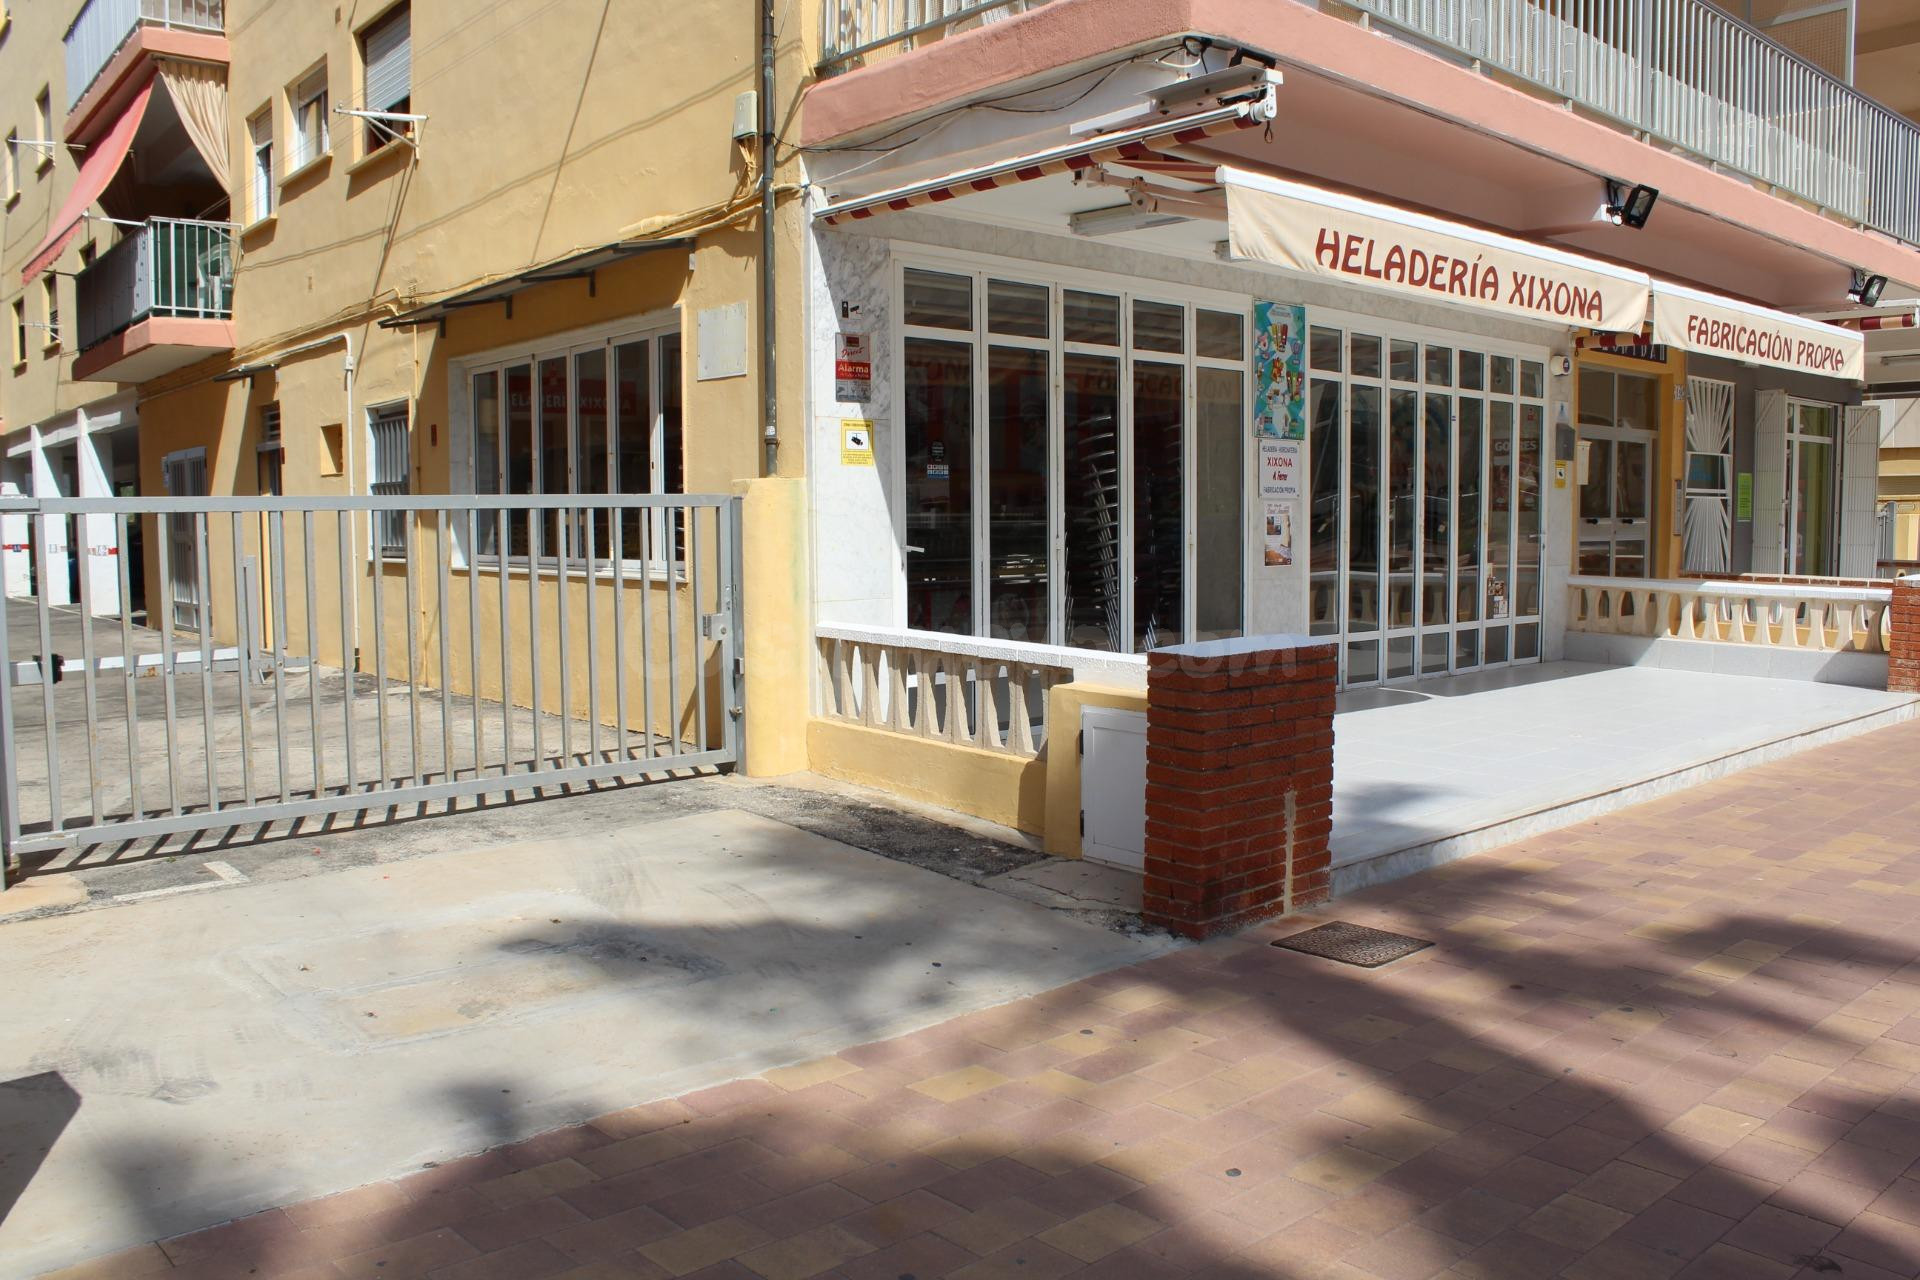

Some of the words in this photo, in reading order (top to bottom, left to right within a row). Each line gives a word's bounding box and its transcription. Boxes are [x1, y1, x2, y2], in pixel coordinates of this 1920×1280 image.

[1315, 228, 1498, 301] HELADERÍA
[1508, 271, 1603, 323] XIXONA
[1687, 314, 1793, 363] FABRICACIÓN
[1797, 340, 1844, 372] PROPIA
[838, 364, 869, 373] Alarma
[1267, 457, 1292, 468] XIXONA
